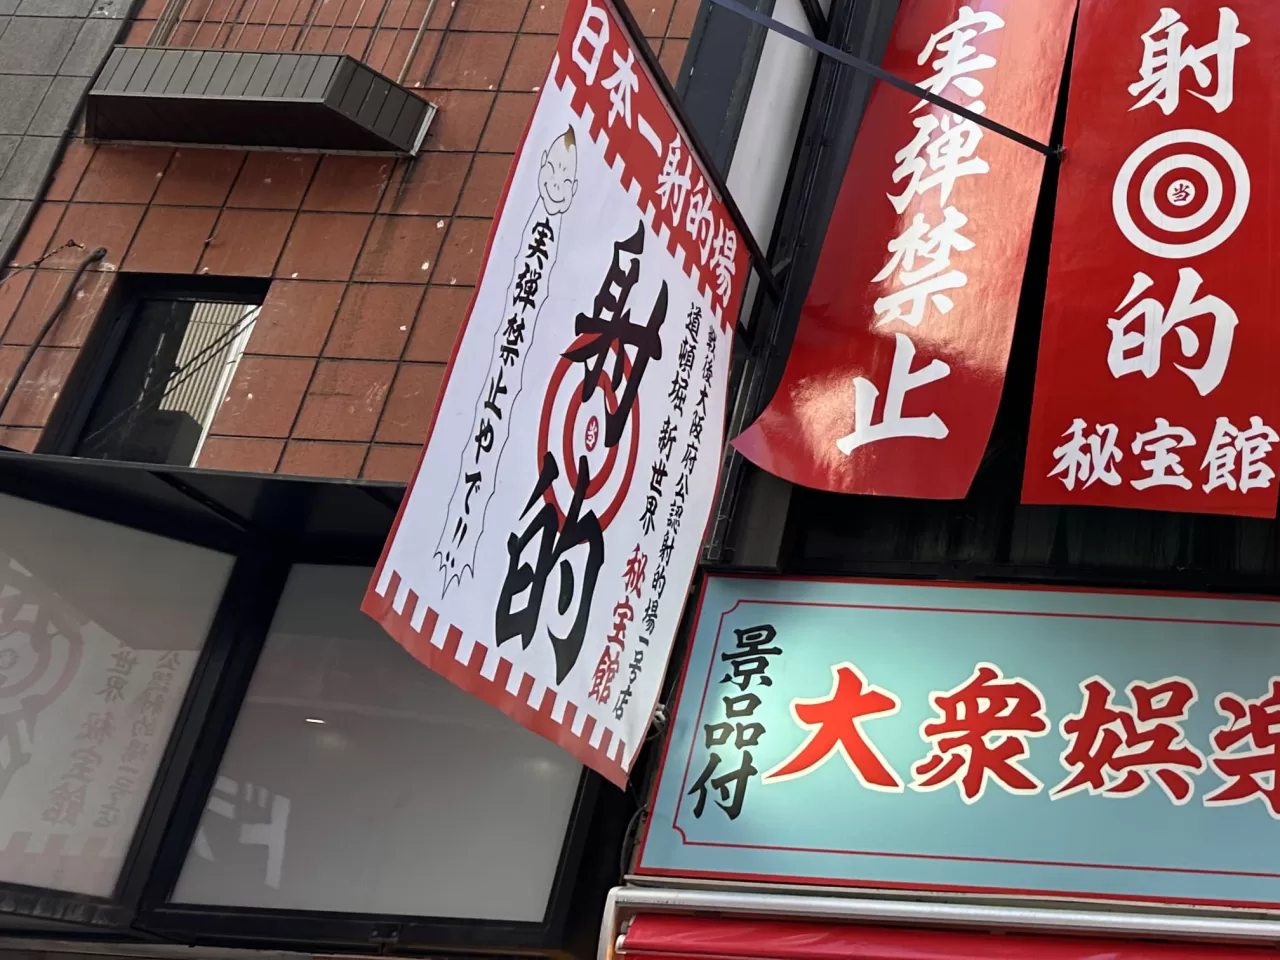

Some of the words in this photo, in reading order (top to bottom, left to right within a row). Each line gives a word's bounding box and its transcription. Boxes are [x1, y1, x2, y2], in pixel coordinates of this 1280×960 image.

[836, 5, 1006, 457] 実弾禁止
[495, 219, 669, 686] 射的
[1046, 415, 1280, 495] 秘宝館
[687, 623, 783, 821] 景品付
